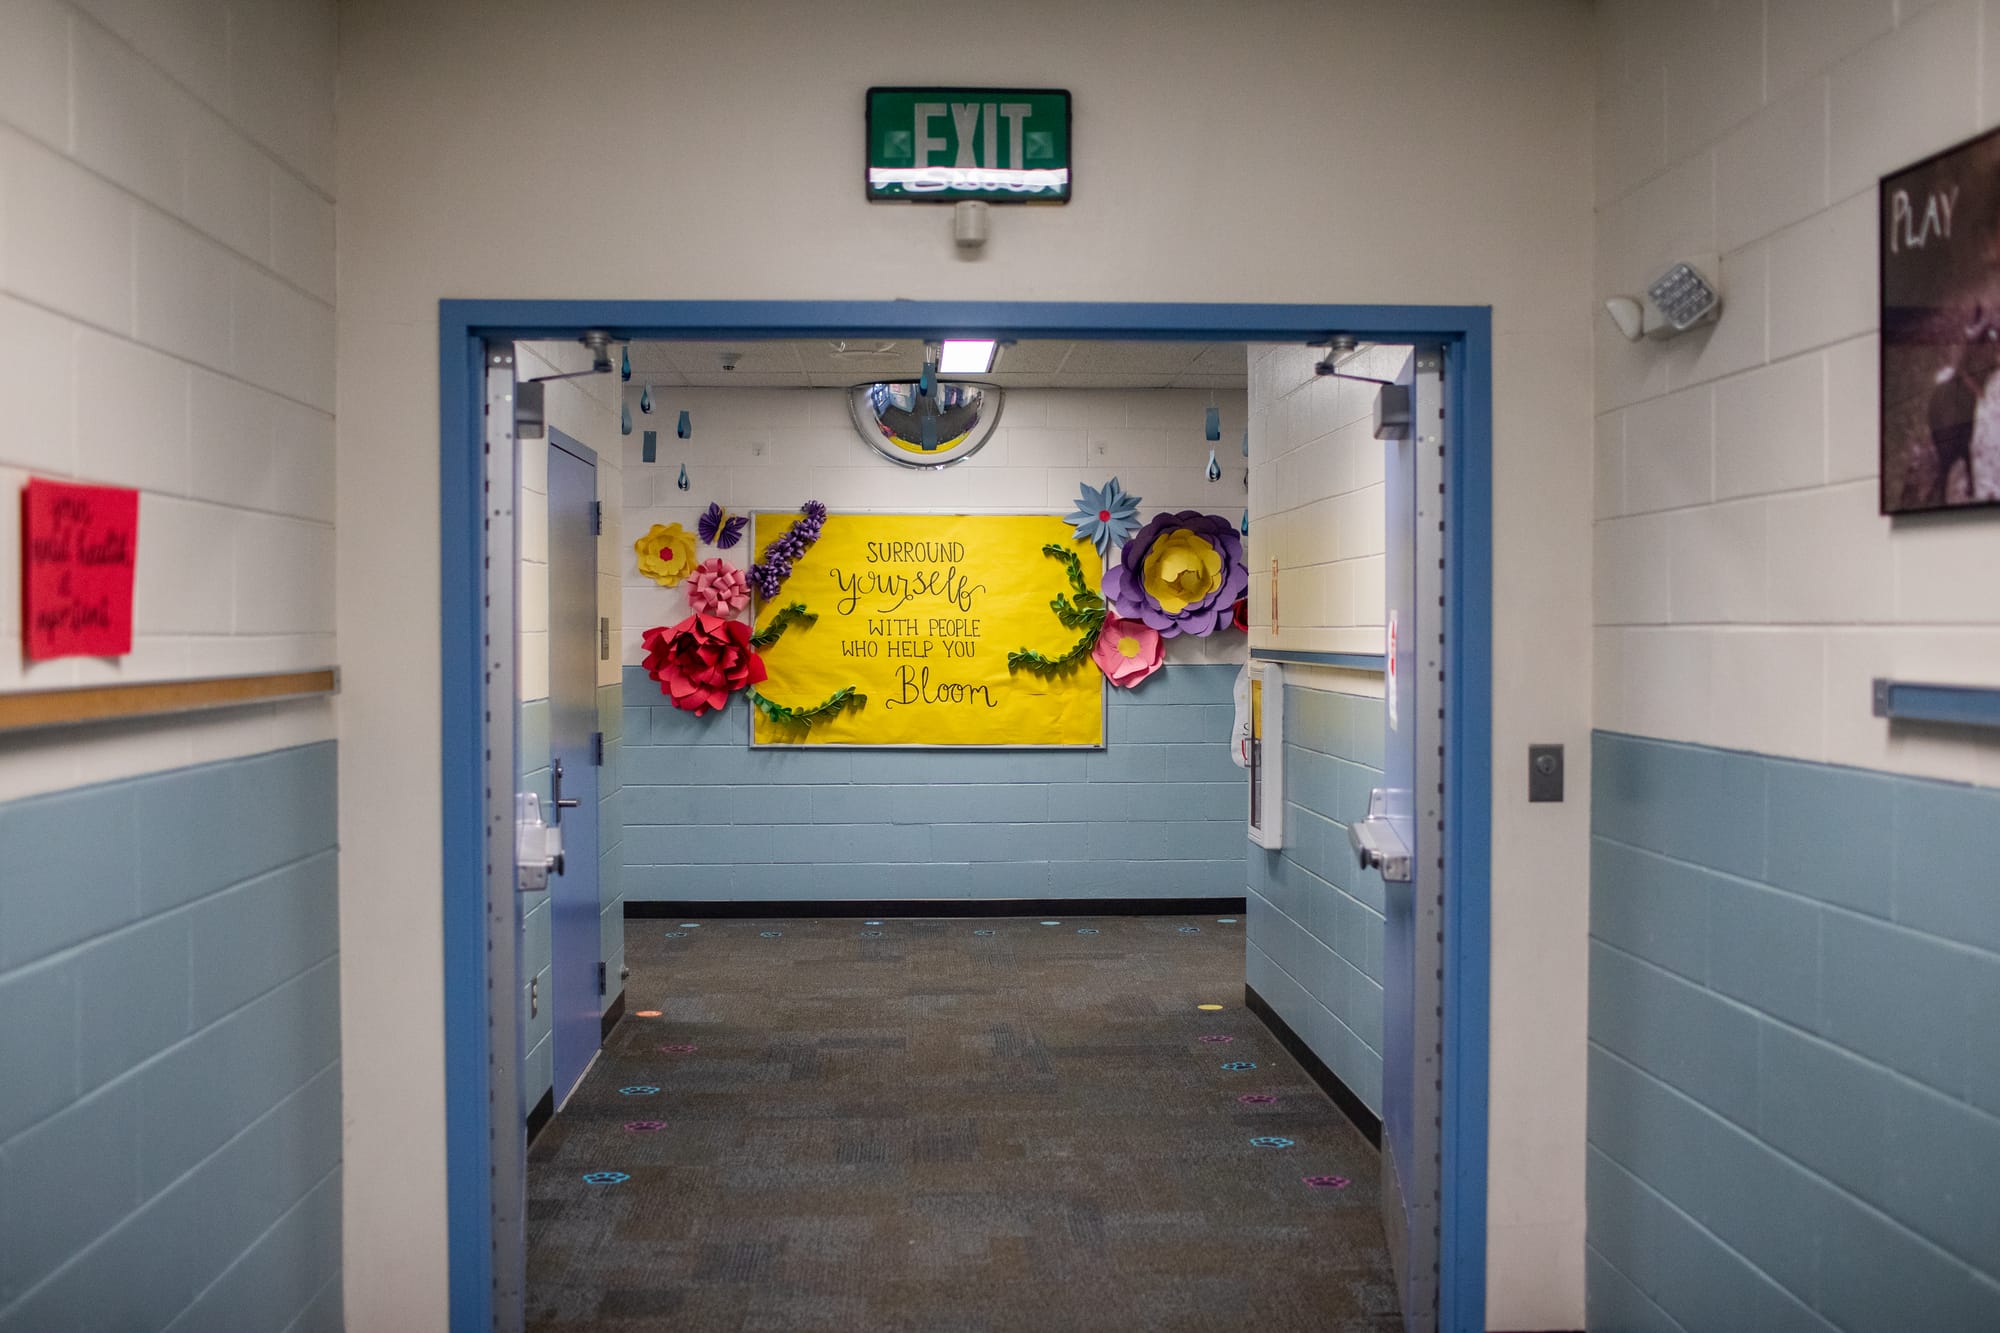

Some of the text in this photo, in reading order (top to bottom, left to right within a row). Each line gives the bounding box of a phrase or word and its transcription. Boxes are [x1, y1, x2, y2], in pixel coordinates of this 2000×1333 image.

[914, 103, 1032, 170] EXIT
[1891, 187, 1959, 253] PLAY
[867, 541, 965, 563] SURROUND
[830, 566, 986, 615] yourself
[841, 640, 975, 658] WHO HELP YOU
[868, 619, 981, 637] WITH PEOPLE
[886, 665, 998, 709] Bloom
